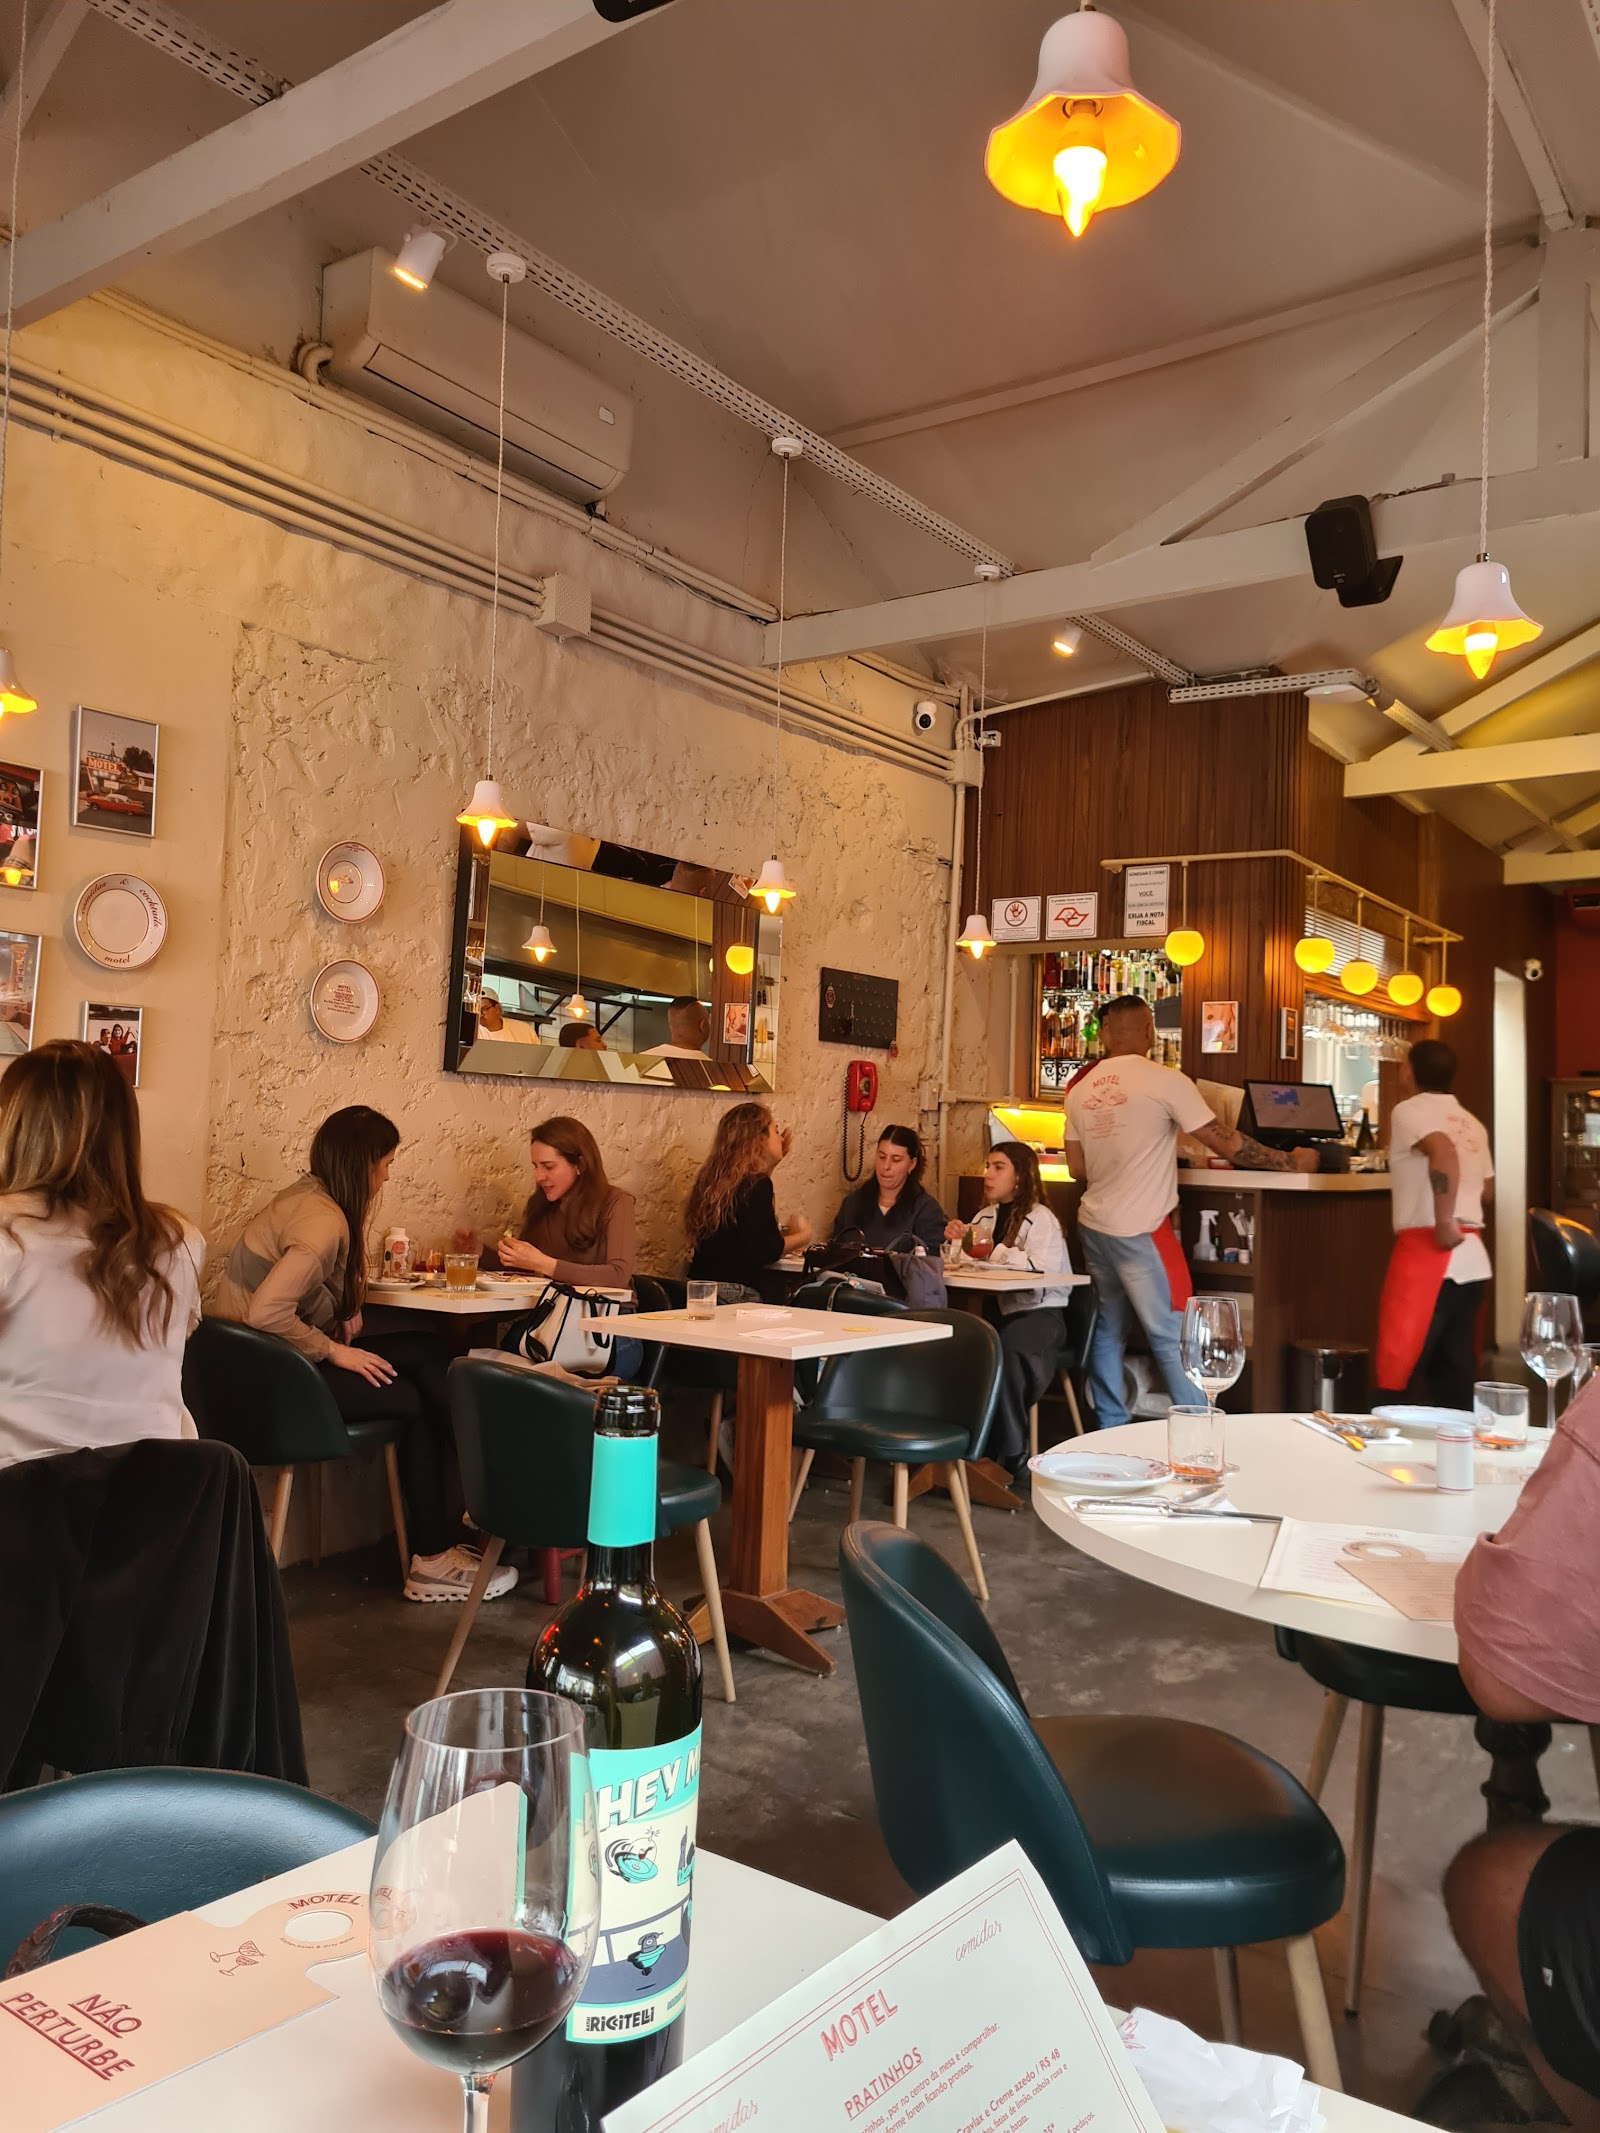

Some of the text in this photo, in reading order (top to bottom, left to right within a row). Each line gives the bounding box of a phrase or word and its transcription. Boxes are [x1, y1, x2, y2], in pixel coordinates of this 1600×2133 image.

[88, 758, 119, 772] MOTEL
[139, 888, 162, 929] cocktails
[104, 954, 130, 964] motel
[1092, 1074, 1120, 1088] MOTEL
[597, 1756, 682, 1832] HEY
[287, 1893, 362, 1910] MOTEL
[3, 1991, 136, 2078] PERTURBE
[74, 1993, 142, 2035] NÃO
[820, 1988, 899, 2061] MOTEL
[844, 2047, 923, 2120] PRATINHOS
[900, 2095, 910, 2107] no
[909, 2078, 930, 2098] centro
[930, 2070, 940, 2081] da
[939, 2057, 956, 2075] mesa
[961, 2022, 1000, 2058] compartilhar.
[990, 2088, 1015, 2112] Creme
[1014, 2071, 1036, 2092] azedo
[1039, 2056, 1051, 2071] R$
[1051, 2048, 1061, 2062] 48
[1031, 2077, 1051, 2096] cebola
[1050, 2067, 1064, 2082] roxa
[905, 2101, 926, 2120] forem
[924, 2082, 948, 2105] ficando
[948, 2061, 974, 2089] prontos.
